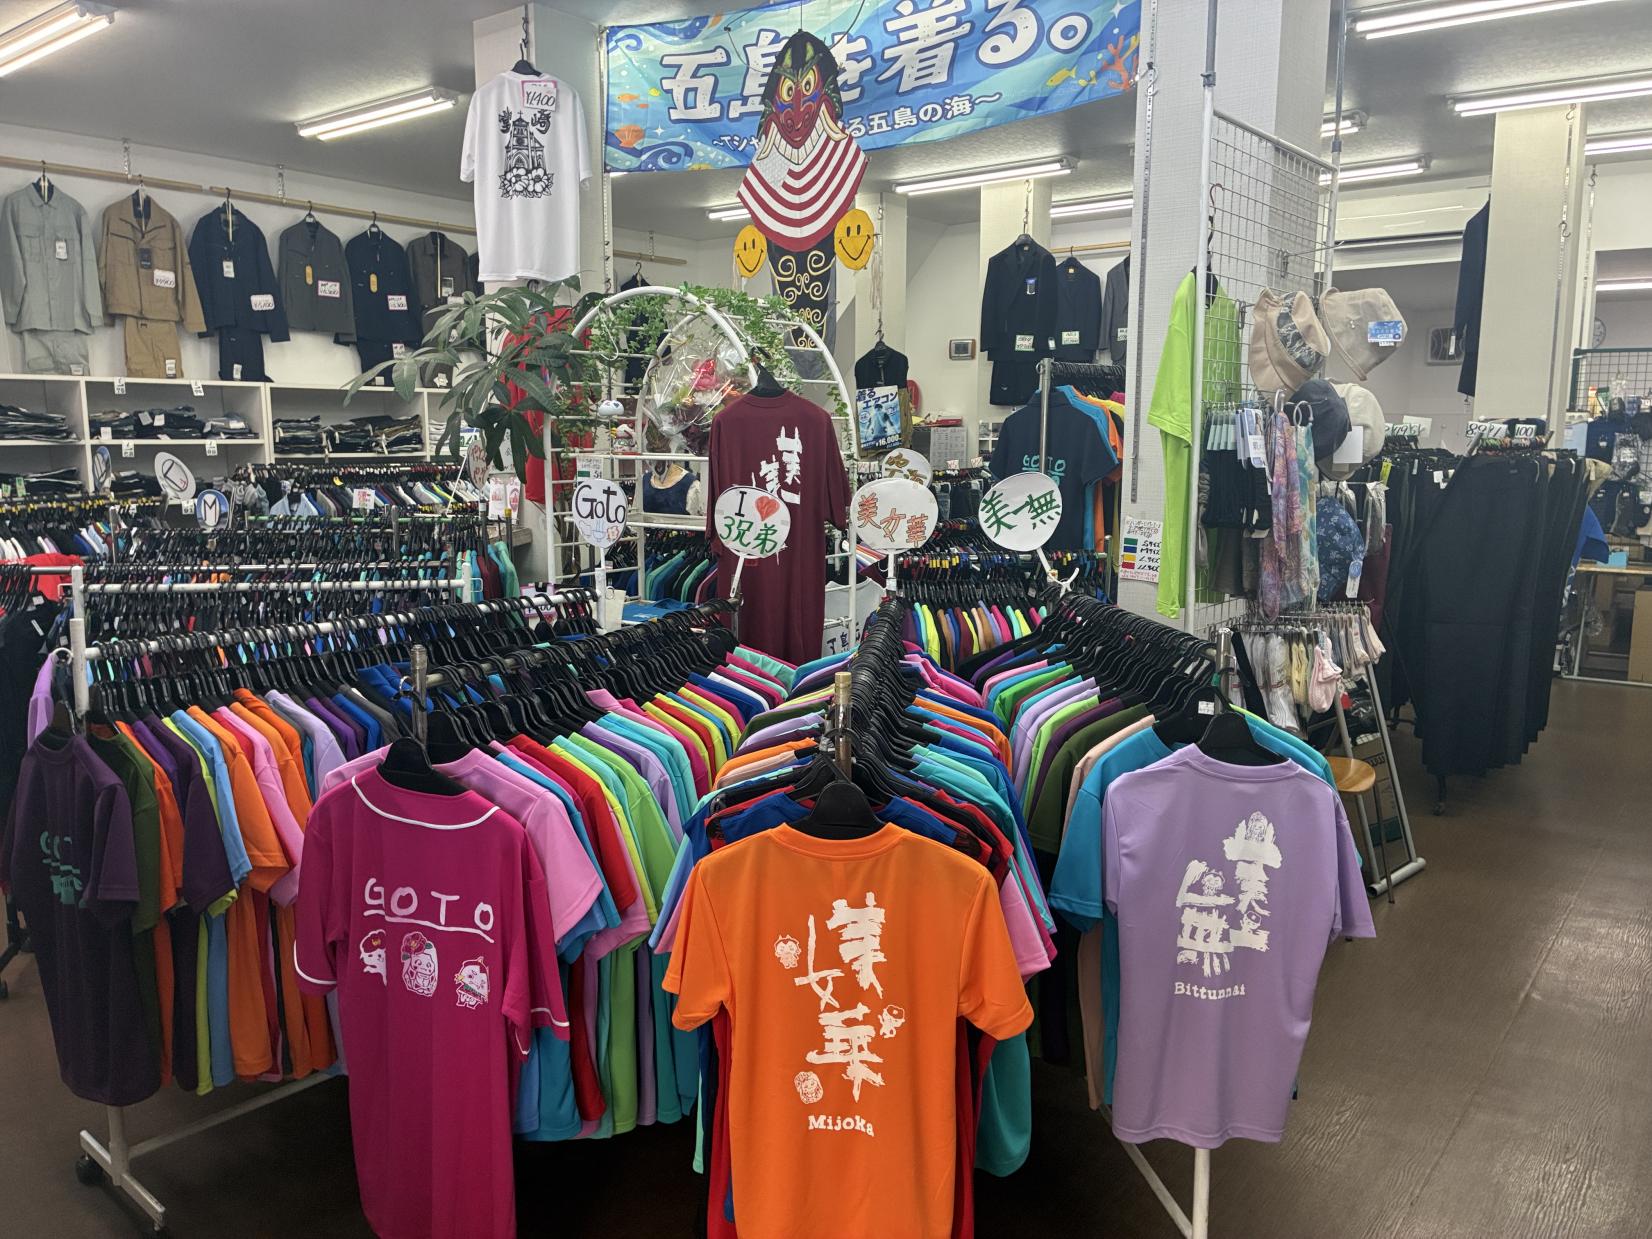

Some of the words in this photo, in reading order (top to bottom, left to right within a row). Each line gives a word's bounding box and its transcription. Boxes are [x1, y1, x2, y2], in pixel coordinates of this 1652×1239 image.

[862, 392, 898, 410] エアコン
[1515, 426, 1534, 436] 100
[203, 499, 217, 523] M
[575, 484, 626, 524] Goto
[735, 491, 747, 517] I
[720, 516, 778, 554] 3兄弟
[364, 877, 494, 931] GOTO
[808, 1114, 875, 1137] Mijoka
